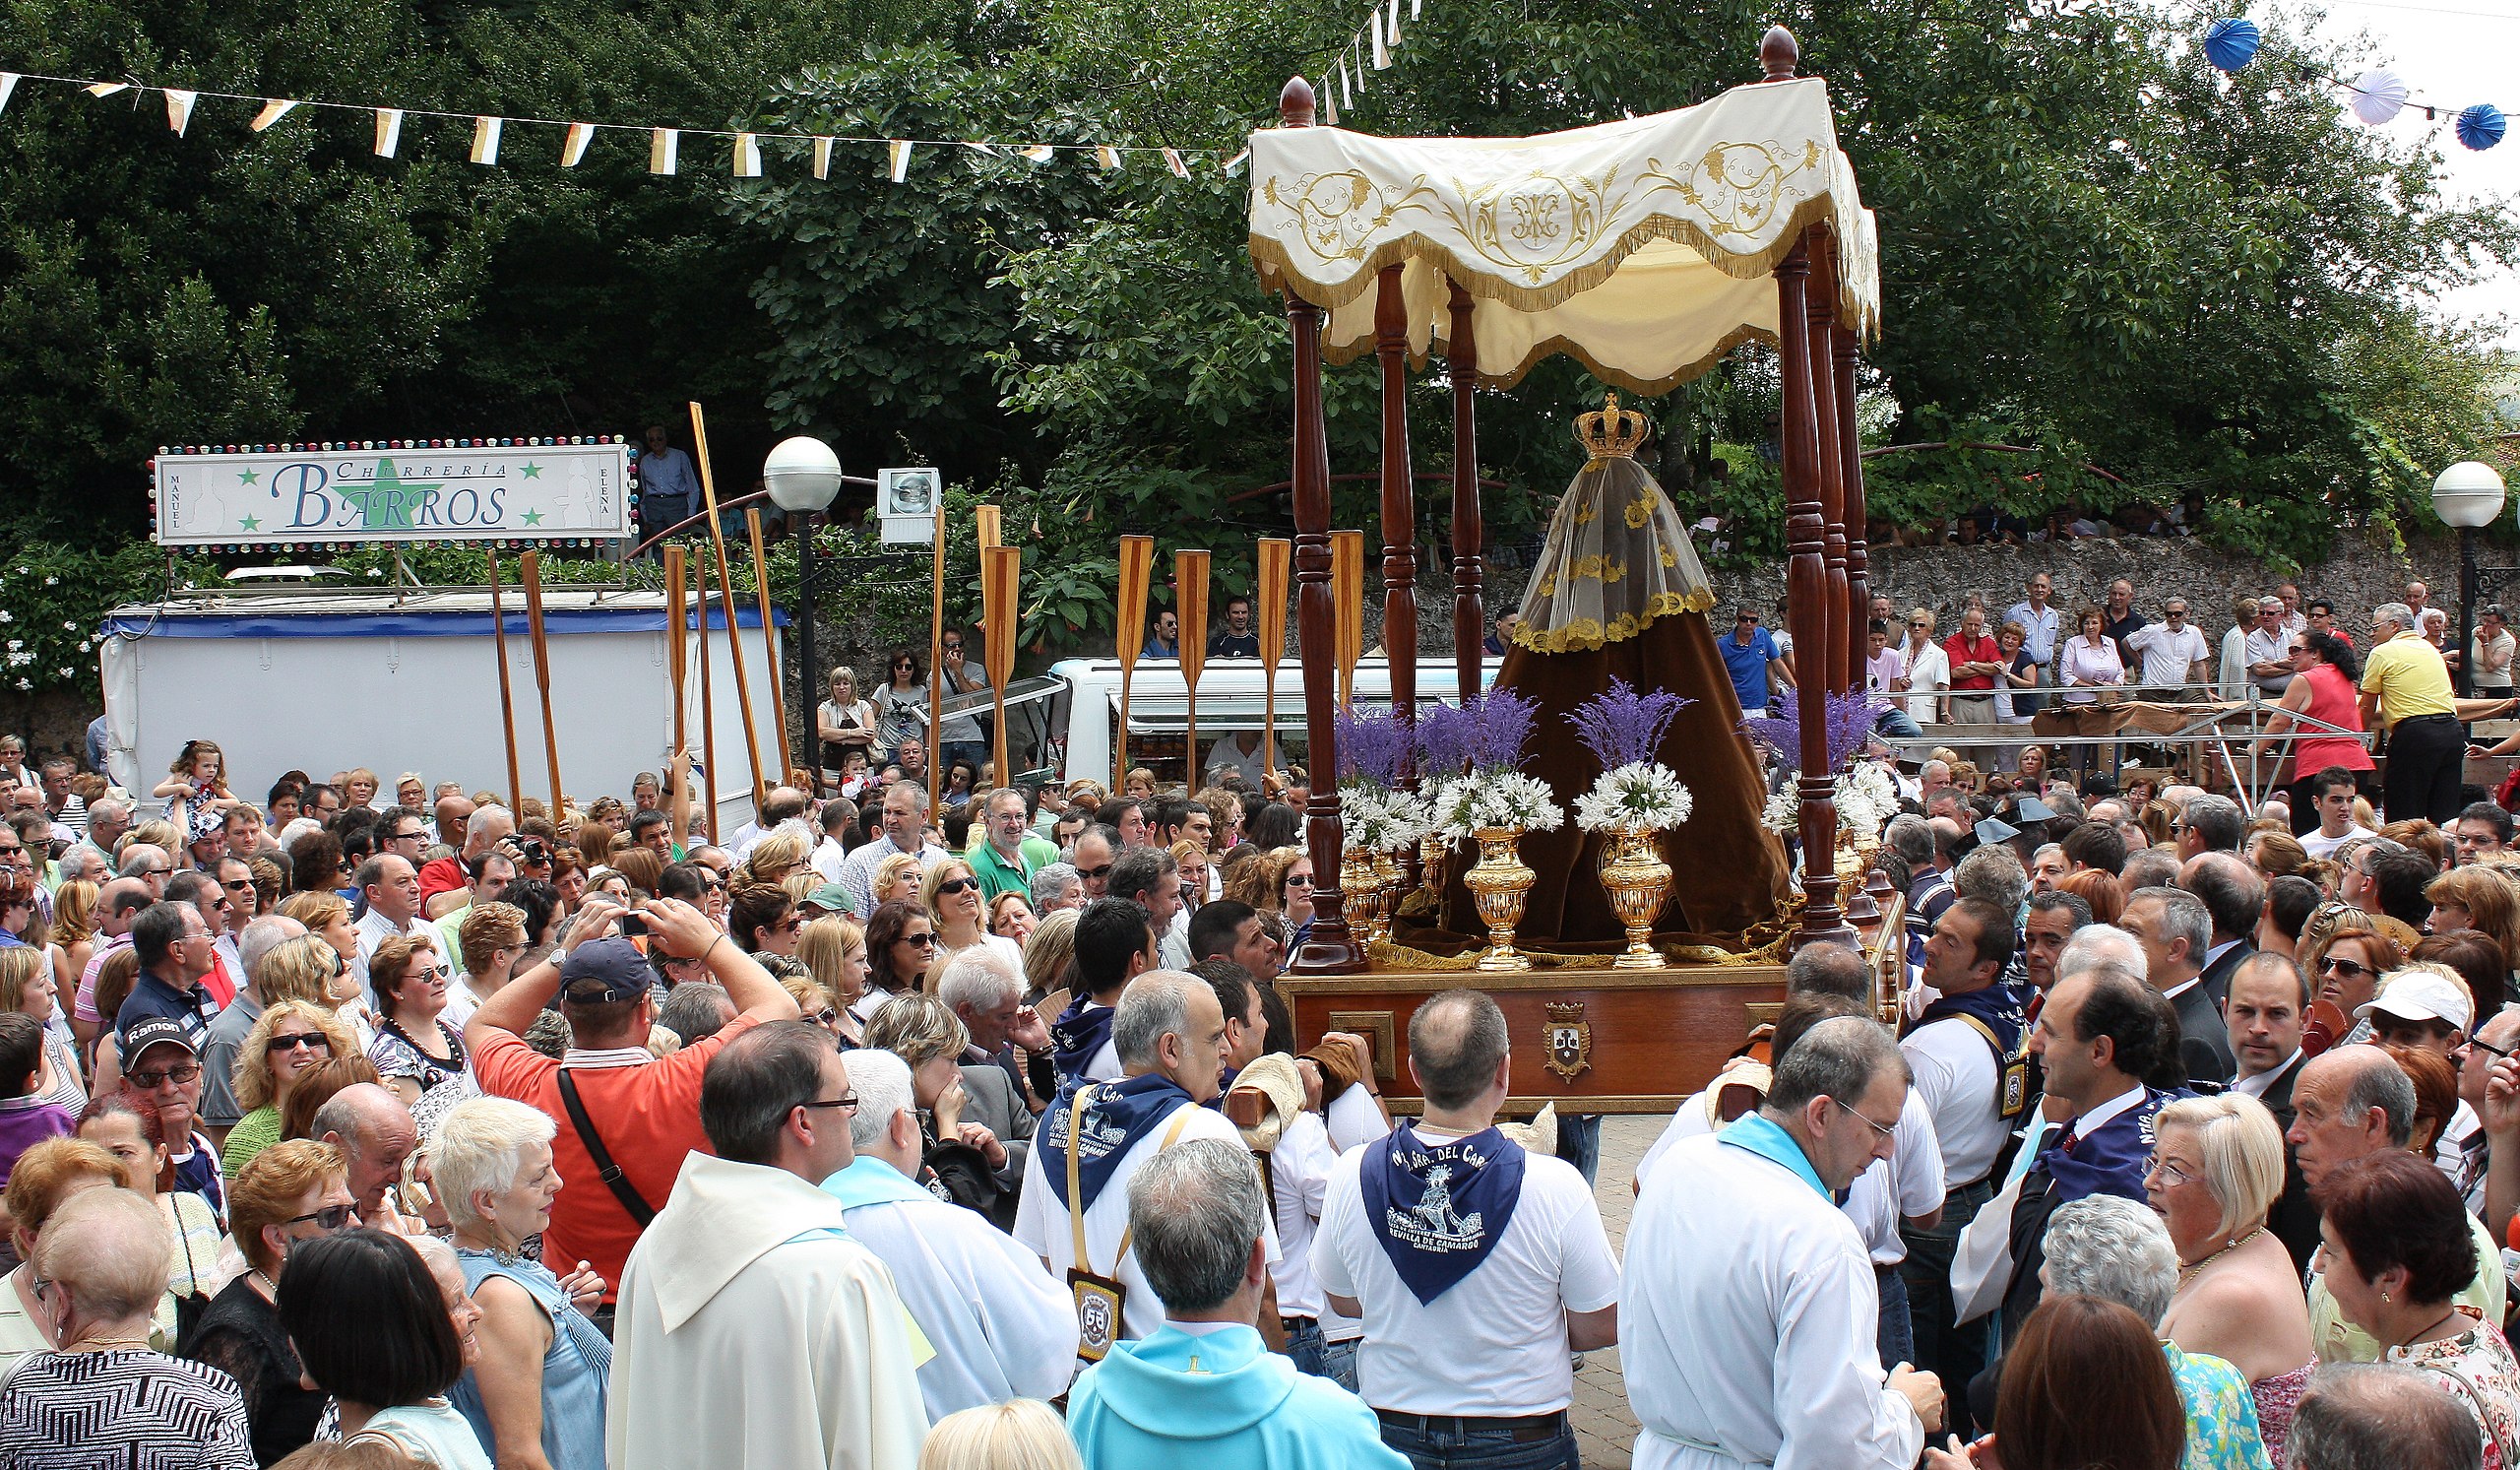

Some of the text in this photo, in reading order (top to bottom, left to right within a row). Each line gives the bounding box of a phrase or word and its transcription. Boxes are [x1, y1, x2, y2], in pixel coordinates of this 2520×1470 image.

[337, 462, 506, 478] CHURRERÍA
[170, 476, 179, 529] MANUEL
[271, 463, 506, 528] BARROS
[600, 469, 609, 514] ELENA
[129, 1022, 181, 1045] Ramon
[1412, 1149, 1435, 1169] SRA.
[1437, 1145, 1458, 1162] DEL
[1389, 1227, 1480, 1251] REVILLA DE CAMARGO
